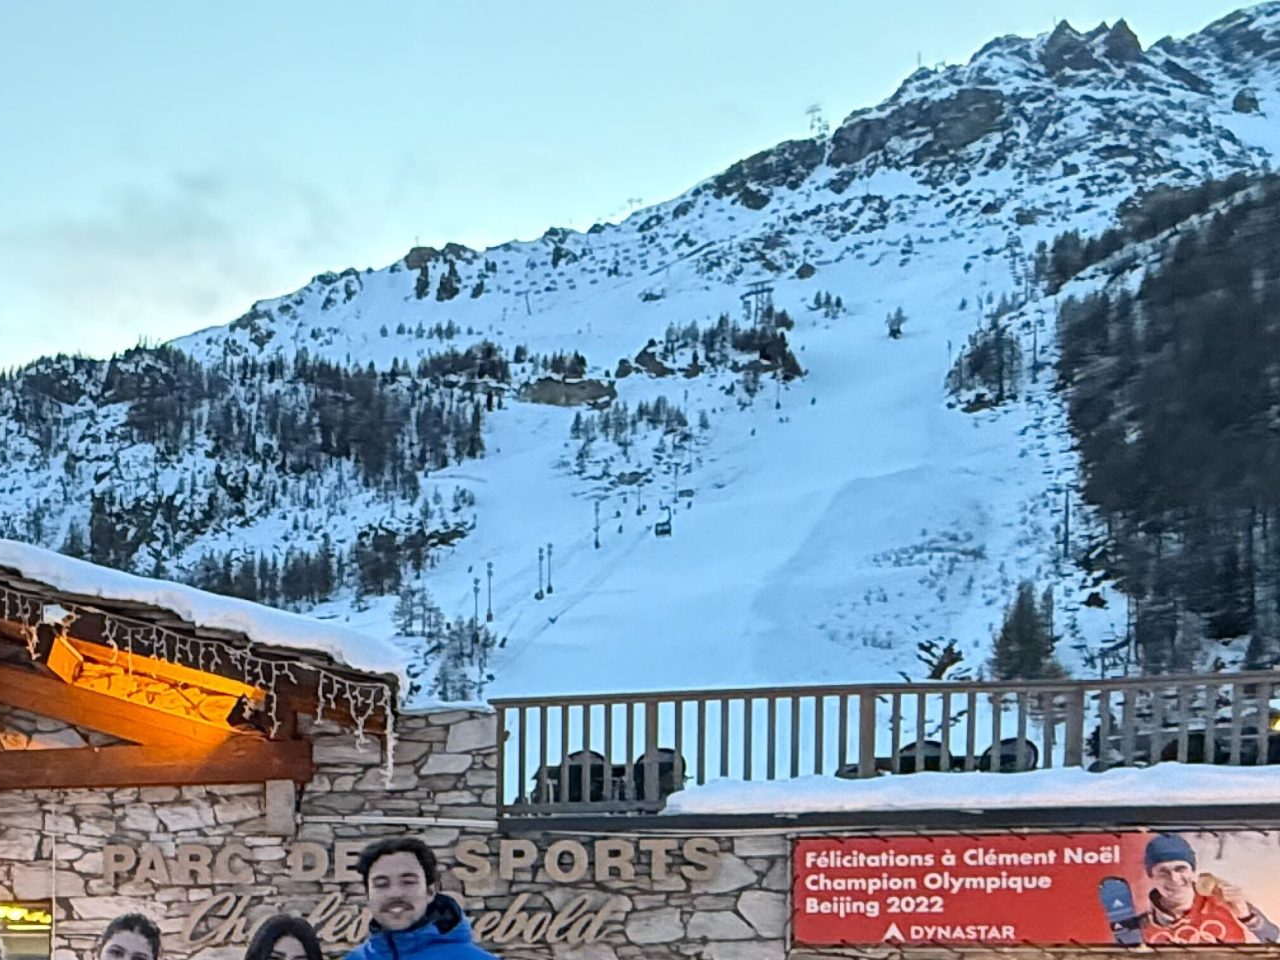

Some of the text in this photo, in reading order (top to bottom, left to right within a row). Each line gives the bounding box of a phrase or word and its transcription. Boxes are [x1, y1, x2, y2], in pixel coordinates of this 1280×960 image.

[103, 837, 720, 885] PARC DE SPORTS
[805, 844, 1120, 868] Félicitations à Clément Noël
[805, 870, 1052, 895] Champion Olympique
[186, 891, 613, 945] Chles ebold
[805, 895, 944, 918] Beijing 2022
[910, 924, 1016, 940] DYNASTAR
